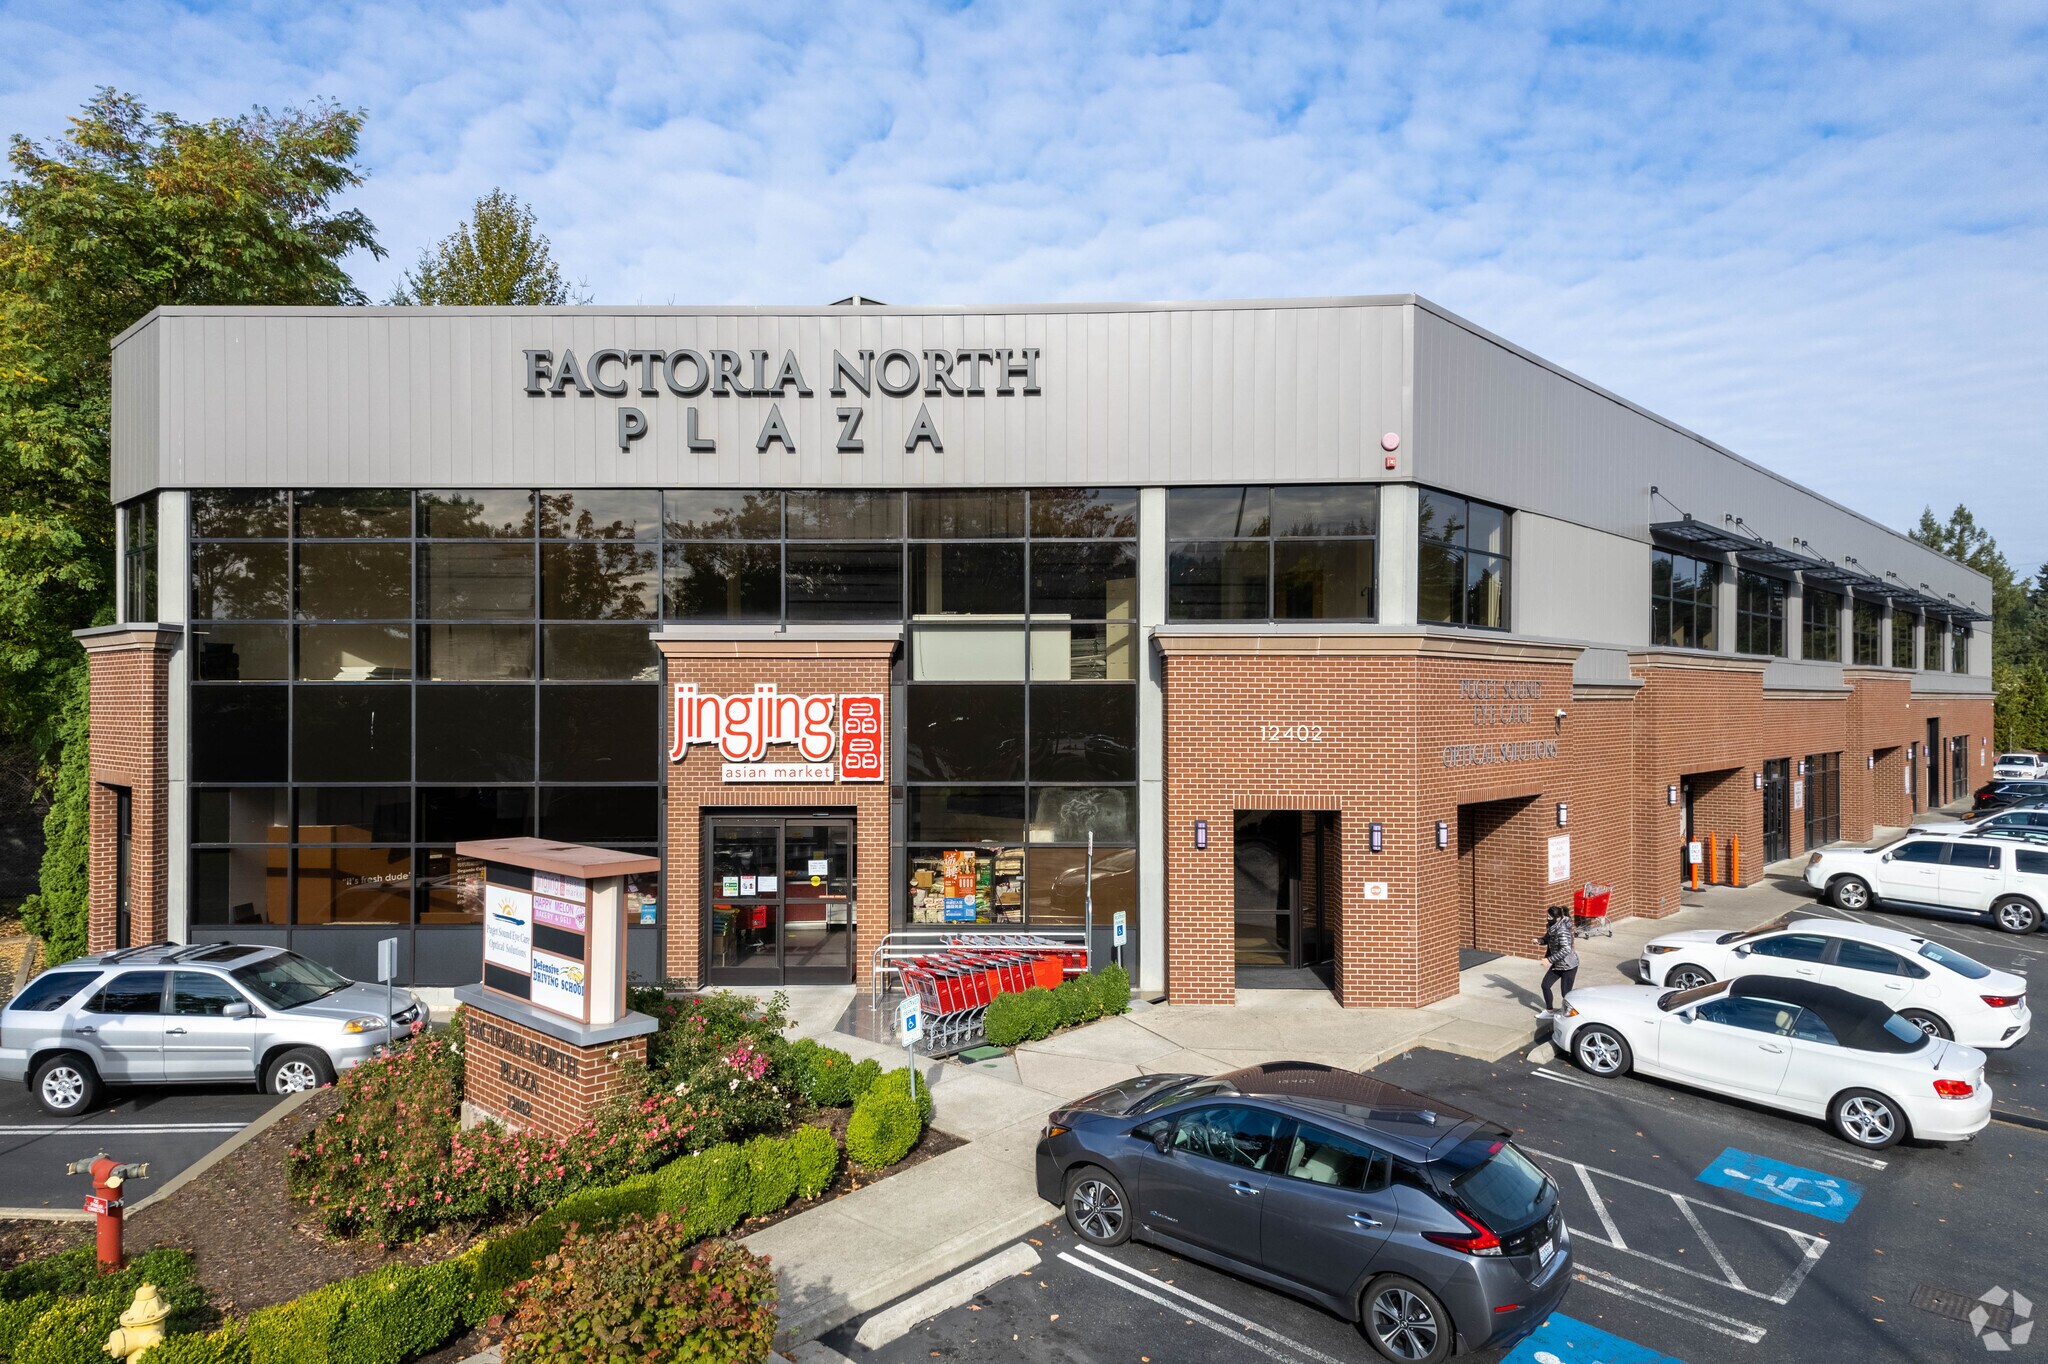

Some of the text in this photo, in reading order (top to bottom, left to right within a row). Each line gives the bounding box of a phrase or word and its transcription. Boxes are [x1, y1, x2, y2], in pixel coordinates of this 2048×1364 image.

[522, 348, 1042, 397] FACTORIA NORTH
[1460, 679, 1542, 700] PUGET SOUND
[671, 686, 833, 759] jingjing
[1473, 704, 1531, 725] EYE CARE
[1260, 725, 1323, 742] 12402
[1442, 739, 1558, 768] OPTICAL SOLUTIONS
[725, 765, 831, 778] asian market
[361, 874, 383, 884] fresh
[534, 897, 575, 915] HAPPY MELON
[489, 939, 505, 951] Optical
[499, 928, 511, 940] Sound
[512, 931, 520, 943] Eye
[520, 933, 530, 944] Care
[534, 958, 560, 976] Defensive
[533, 970, 559, 988] DRIVING
[467, 1016, 579, 1081] FACTORIA NORTH
[500, 1059, 541, 1096] PLAZA
